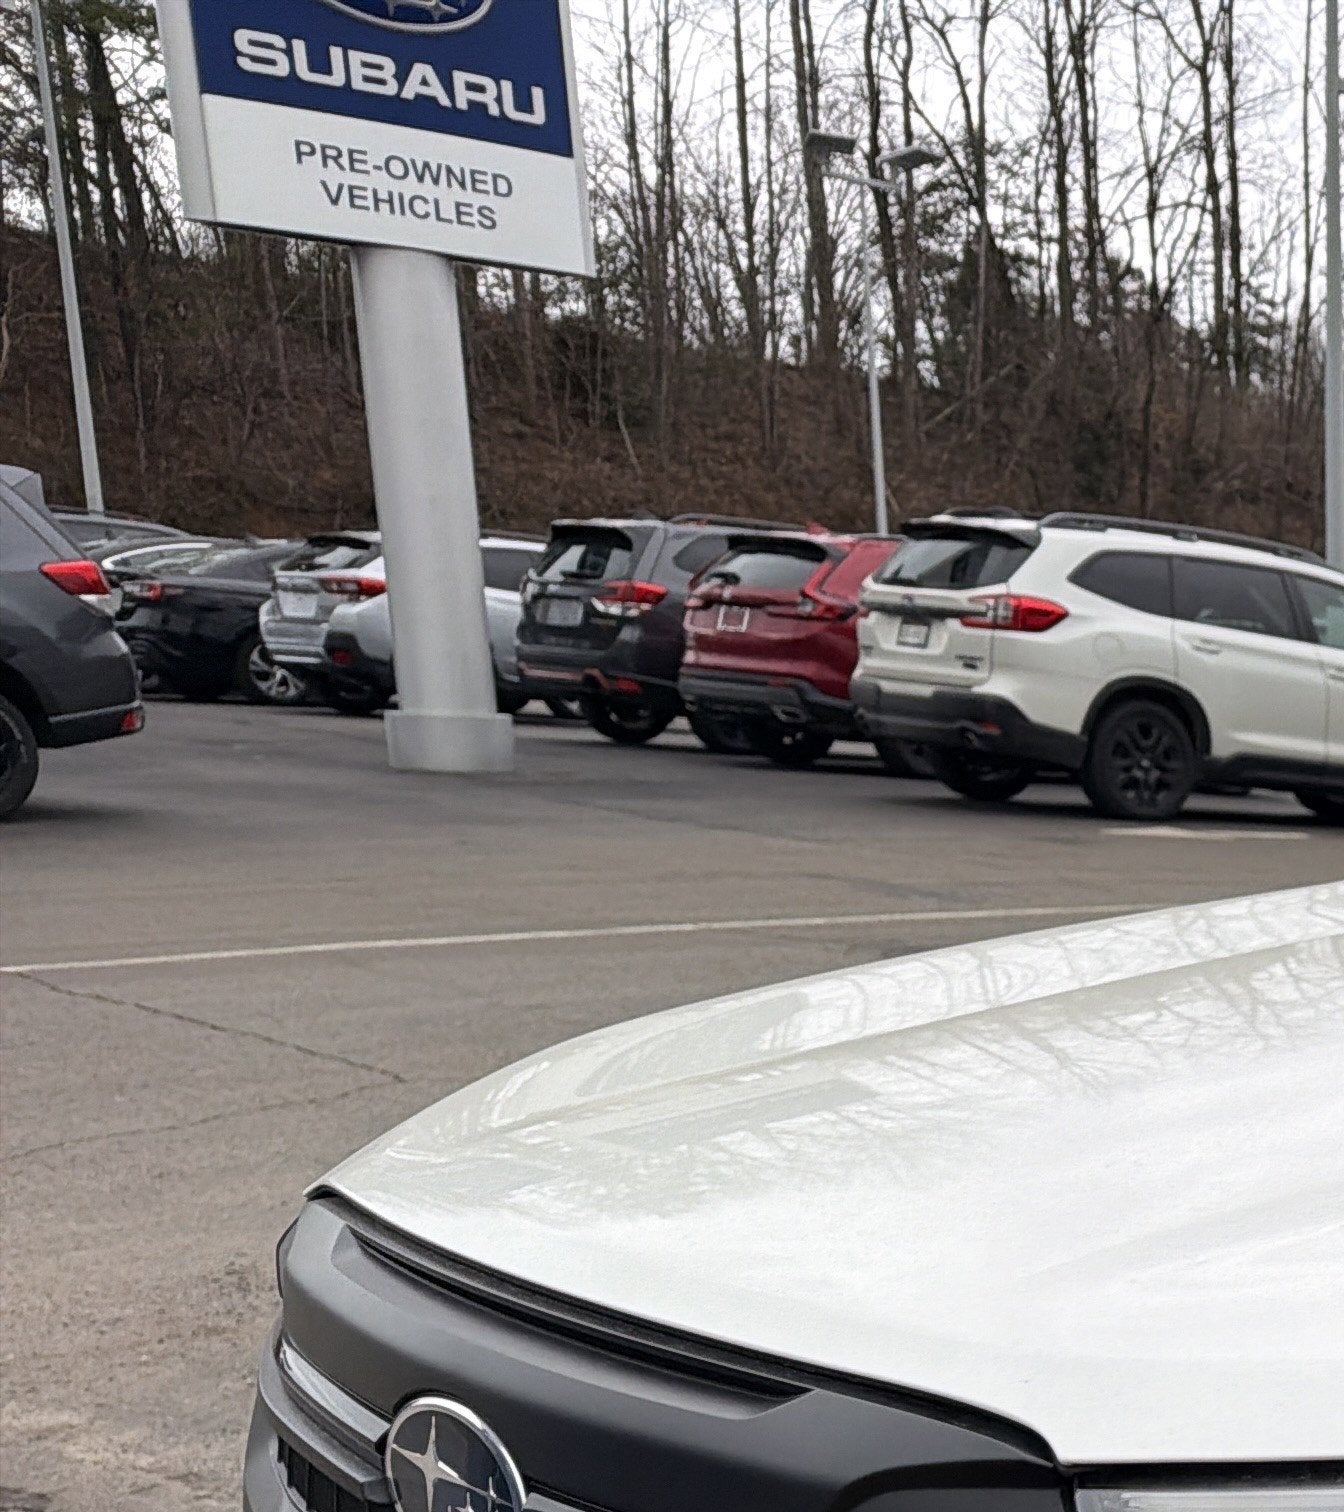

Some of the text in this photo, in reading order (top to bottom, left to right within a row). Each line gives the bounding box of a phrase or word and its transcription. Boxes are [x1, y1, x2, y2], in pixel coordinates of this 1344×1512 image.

[233, 27, 547, 126] SUBARU
[294, 138, 513, 199] PRE-OWNED
[320, 178, 498, 231] VEHICLES
